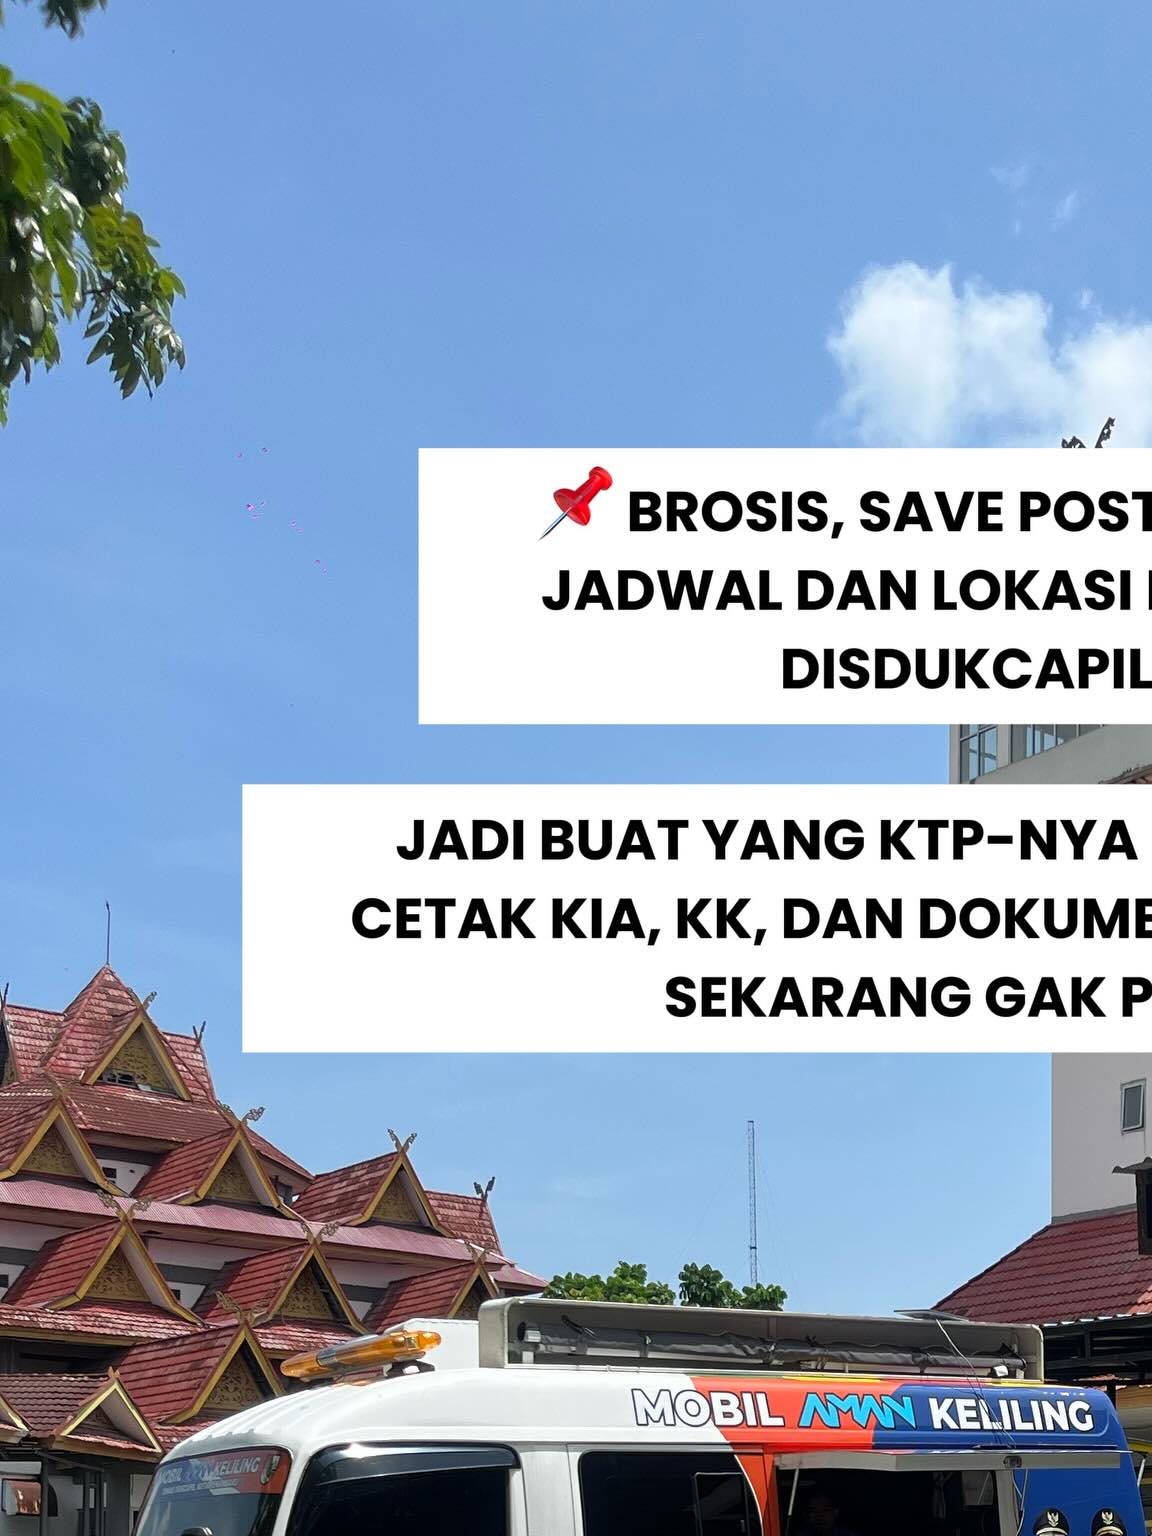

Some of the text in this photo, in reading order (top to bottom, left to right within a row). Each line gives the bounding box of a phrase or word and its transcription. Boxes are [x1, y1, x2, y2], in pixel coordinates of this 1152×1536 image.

[631, 1388, 1094, 1431] MOBIL AMAN KELILING
